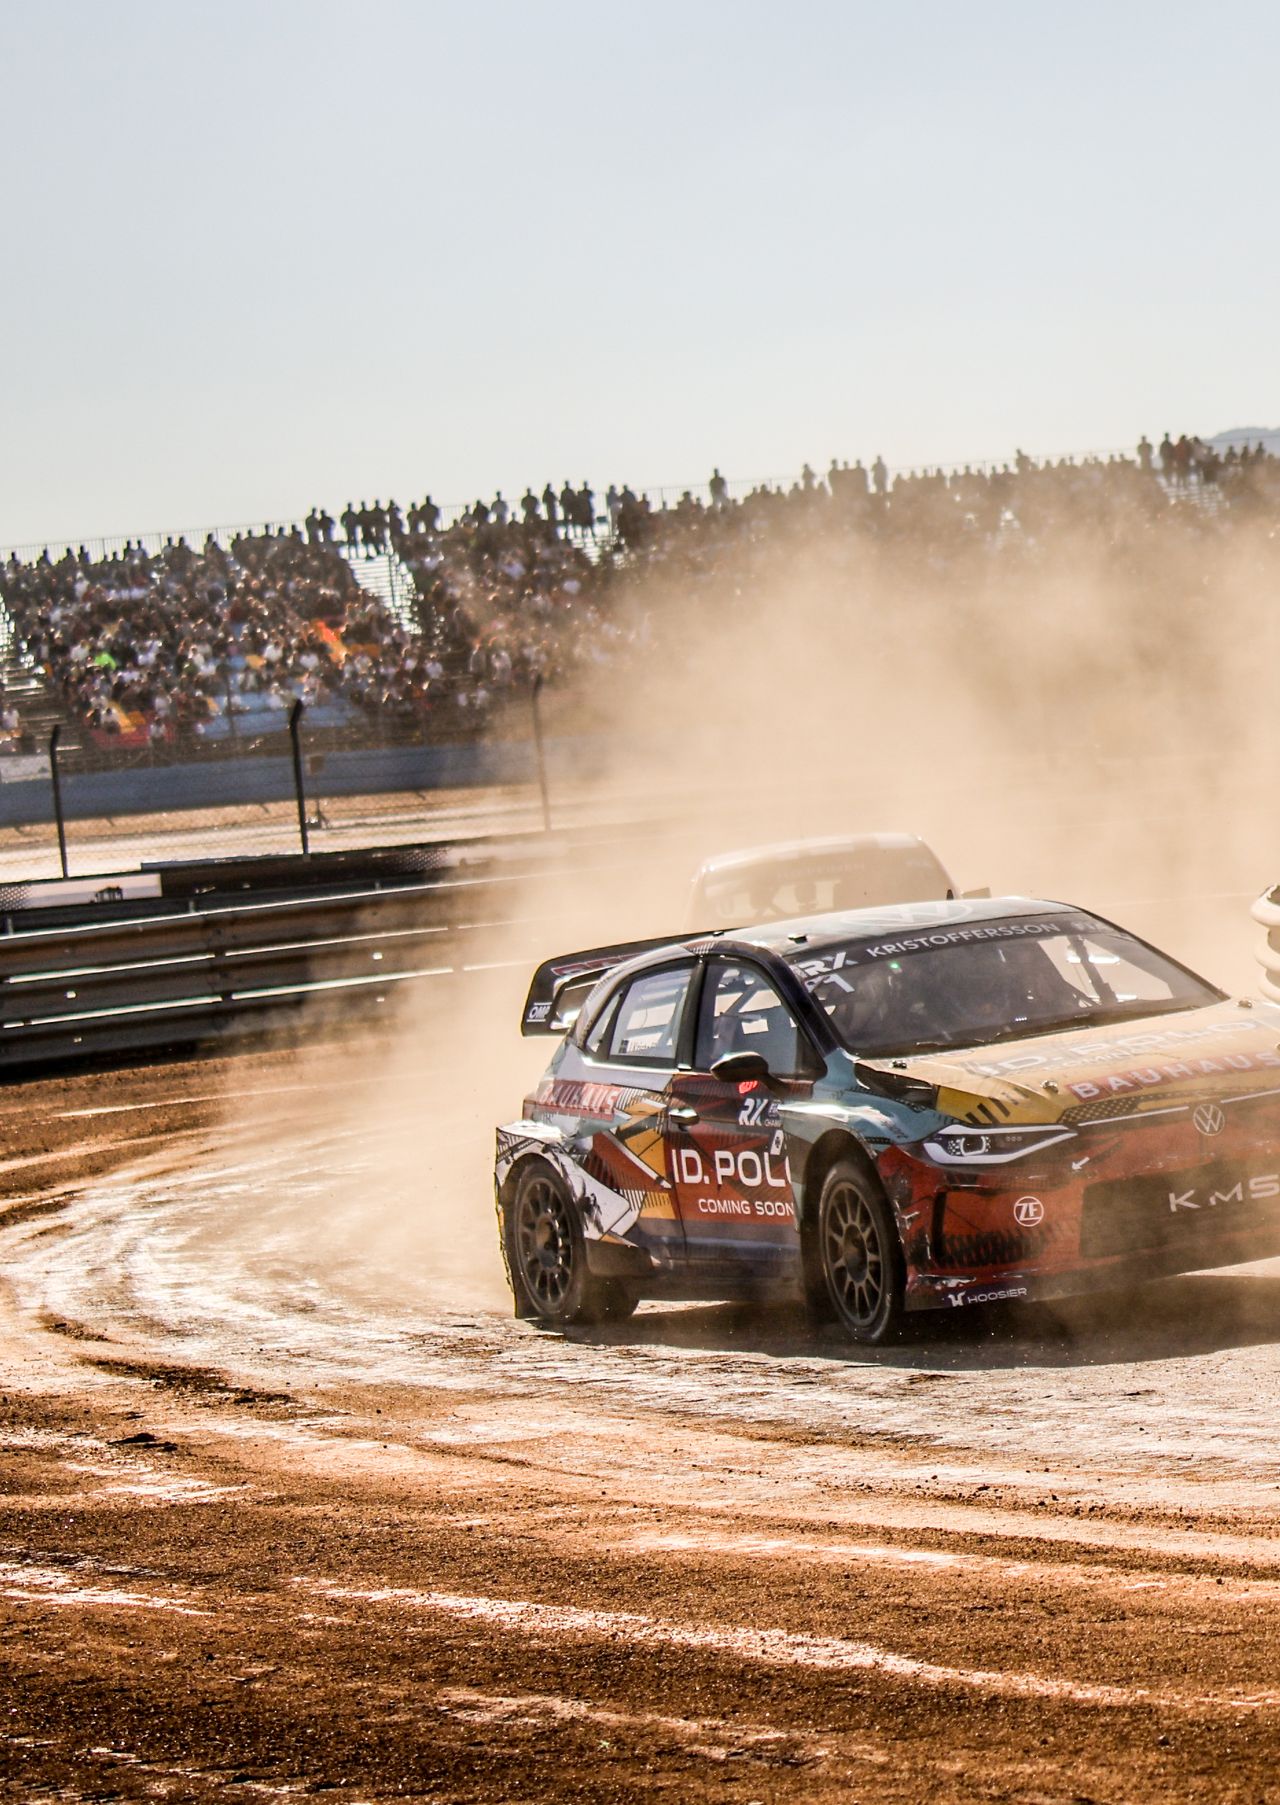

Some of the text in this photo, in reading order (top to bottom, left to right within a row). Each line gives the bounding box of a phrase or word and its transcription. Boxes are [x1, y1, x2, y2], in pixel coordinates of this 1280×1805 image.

[866, 922, 1060, 957] KRISTOFFERSSON
[798, 951, 859, 977] RX
[529, 1006, 550, 1020] OMP
[738, 1098, 768, 1125] RX
[671, 1149, 710, 1185] ID.
[1168, 1174, 1280, 1213] KMS
[699, 1199, 794, 1217] COMING SOON
[1015, 1200, 1044, 1223] ZF
[967, 1286, 1028, 1304] HOOSIER
